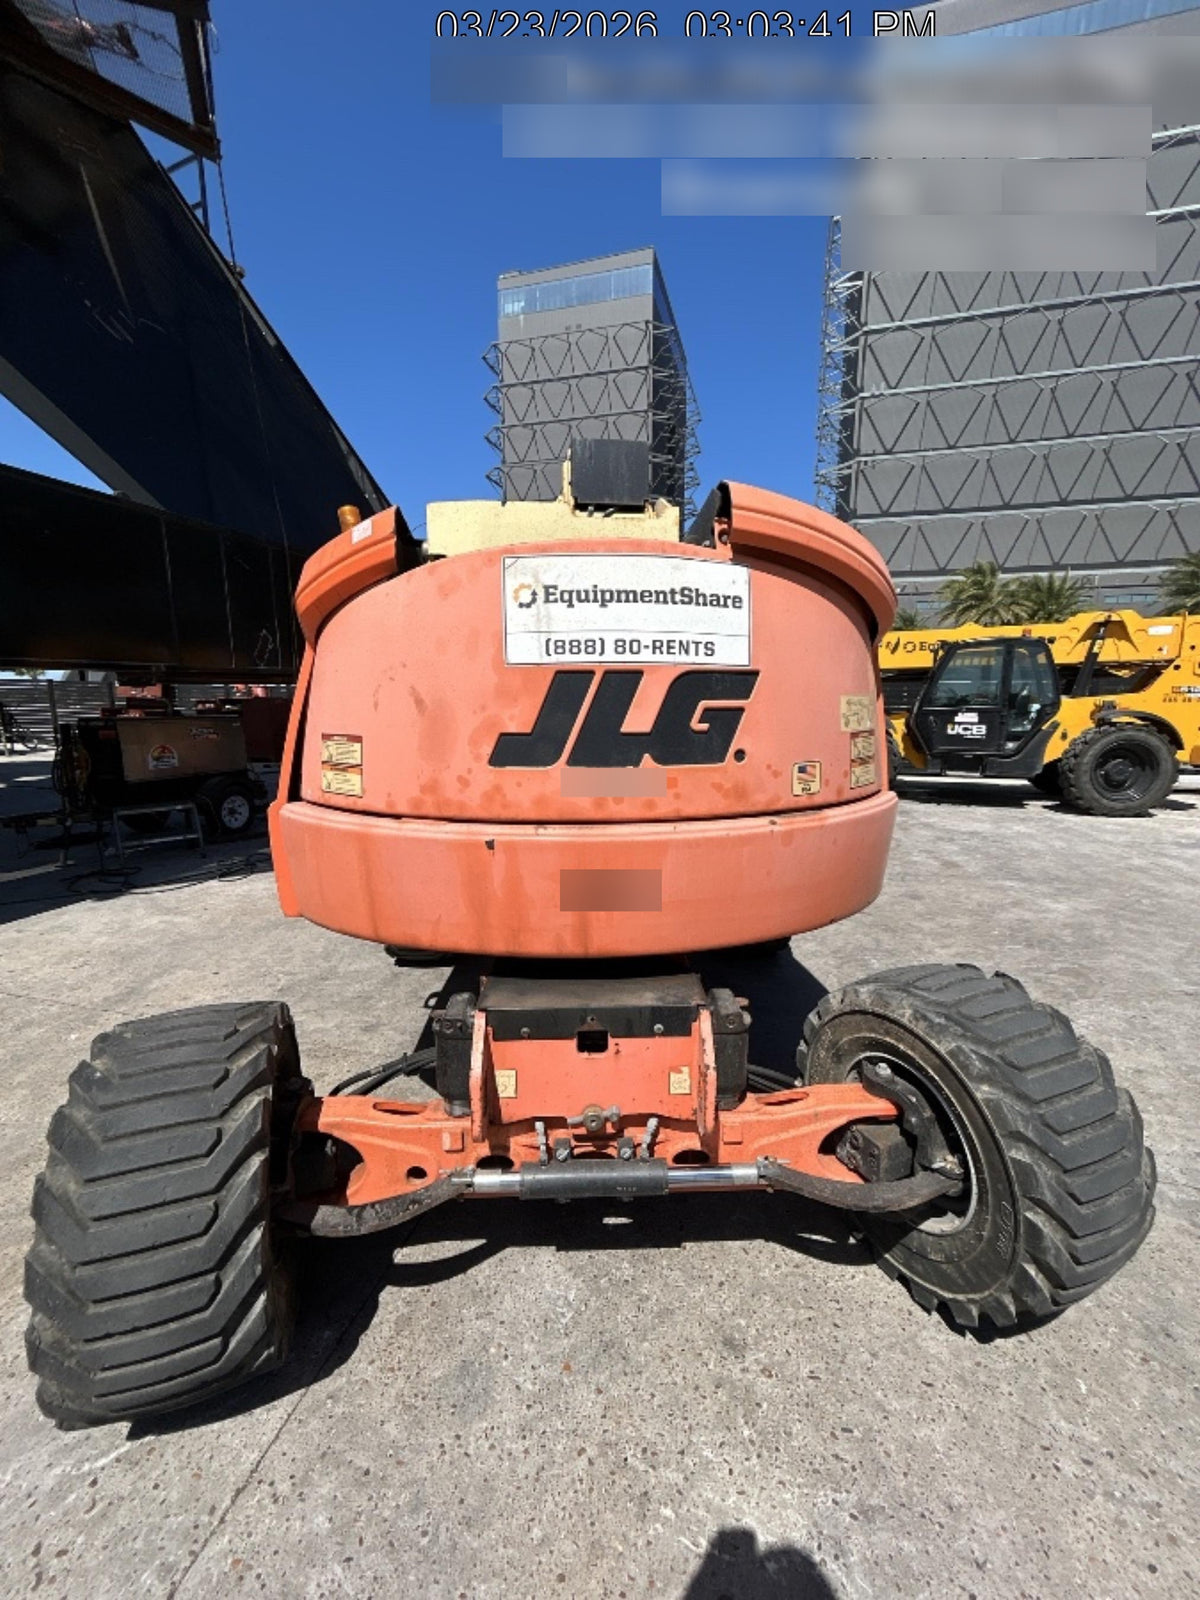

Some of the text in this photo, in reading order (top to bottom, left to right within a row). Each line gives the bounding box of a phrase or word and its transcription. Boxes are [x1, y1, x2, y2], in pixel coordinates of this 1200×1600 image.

[543, 584, 744, 610] EquipmentShare
[545, 637, 717, 658] (888) 80-RENTS
[488, 669, 760, 768] JLG
[947, 723, 987, 735] JCB
